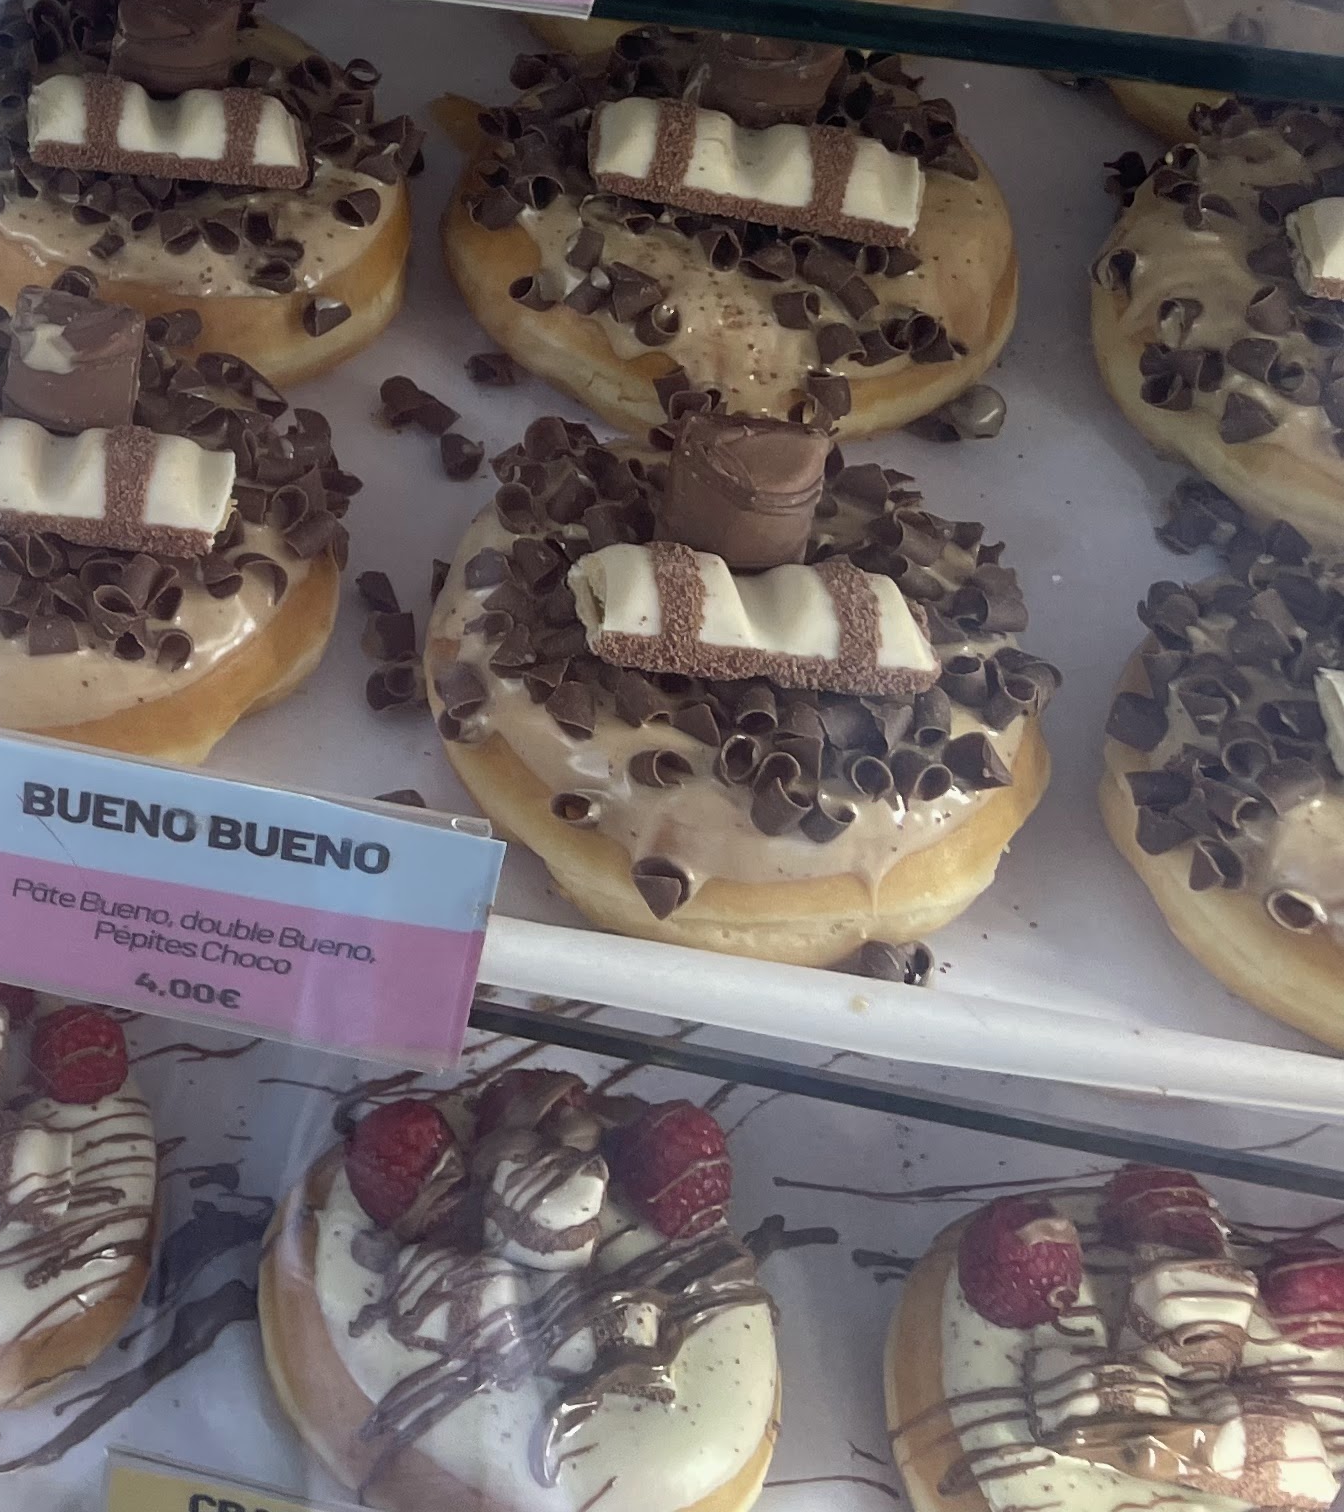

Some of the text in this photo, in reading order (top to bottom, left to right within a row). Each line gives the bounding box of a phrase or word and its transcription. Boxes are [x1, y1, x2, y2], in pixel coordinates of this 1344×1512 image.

[22, 781, 391, 875] BUENO BUENO
[12, 877, 377, 965] Pâte Bueno, double Bueno,
[94, 920, 293, 976] Pépites Choco
